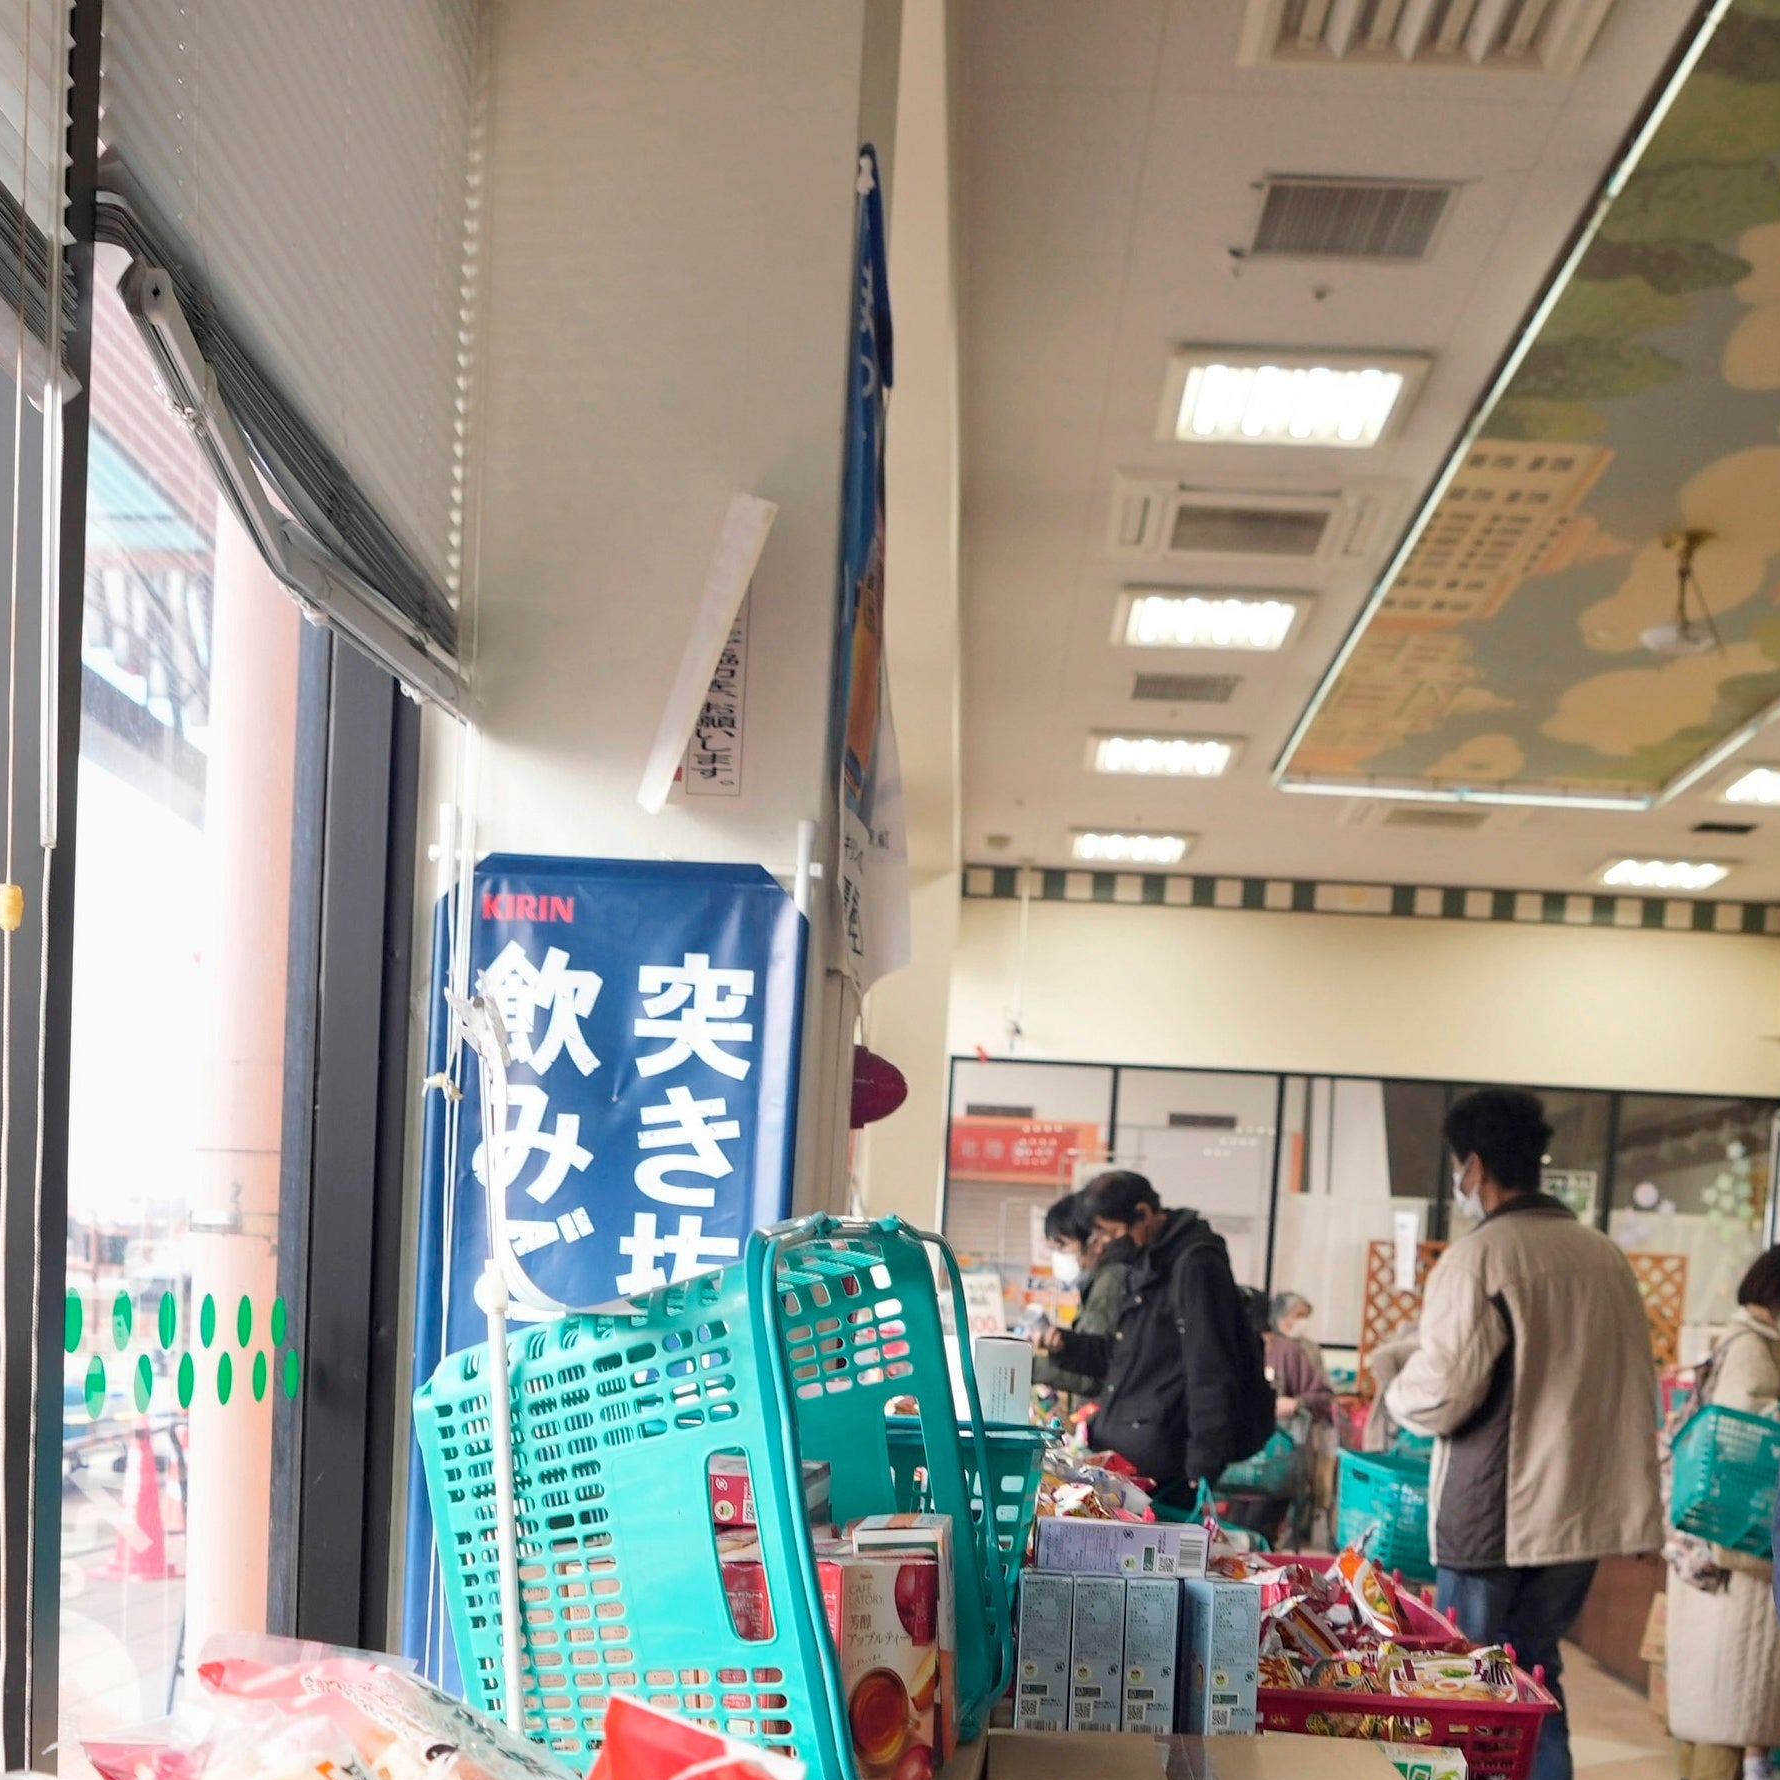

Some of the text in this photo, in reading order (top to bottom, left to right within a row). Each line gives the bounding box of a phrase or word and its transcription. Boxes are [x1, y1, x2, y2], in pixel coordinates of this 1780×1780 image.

[481, 893, 575, 924] KIRIN
[847, 1631, 910, 1648] アップルティー
